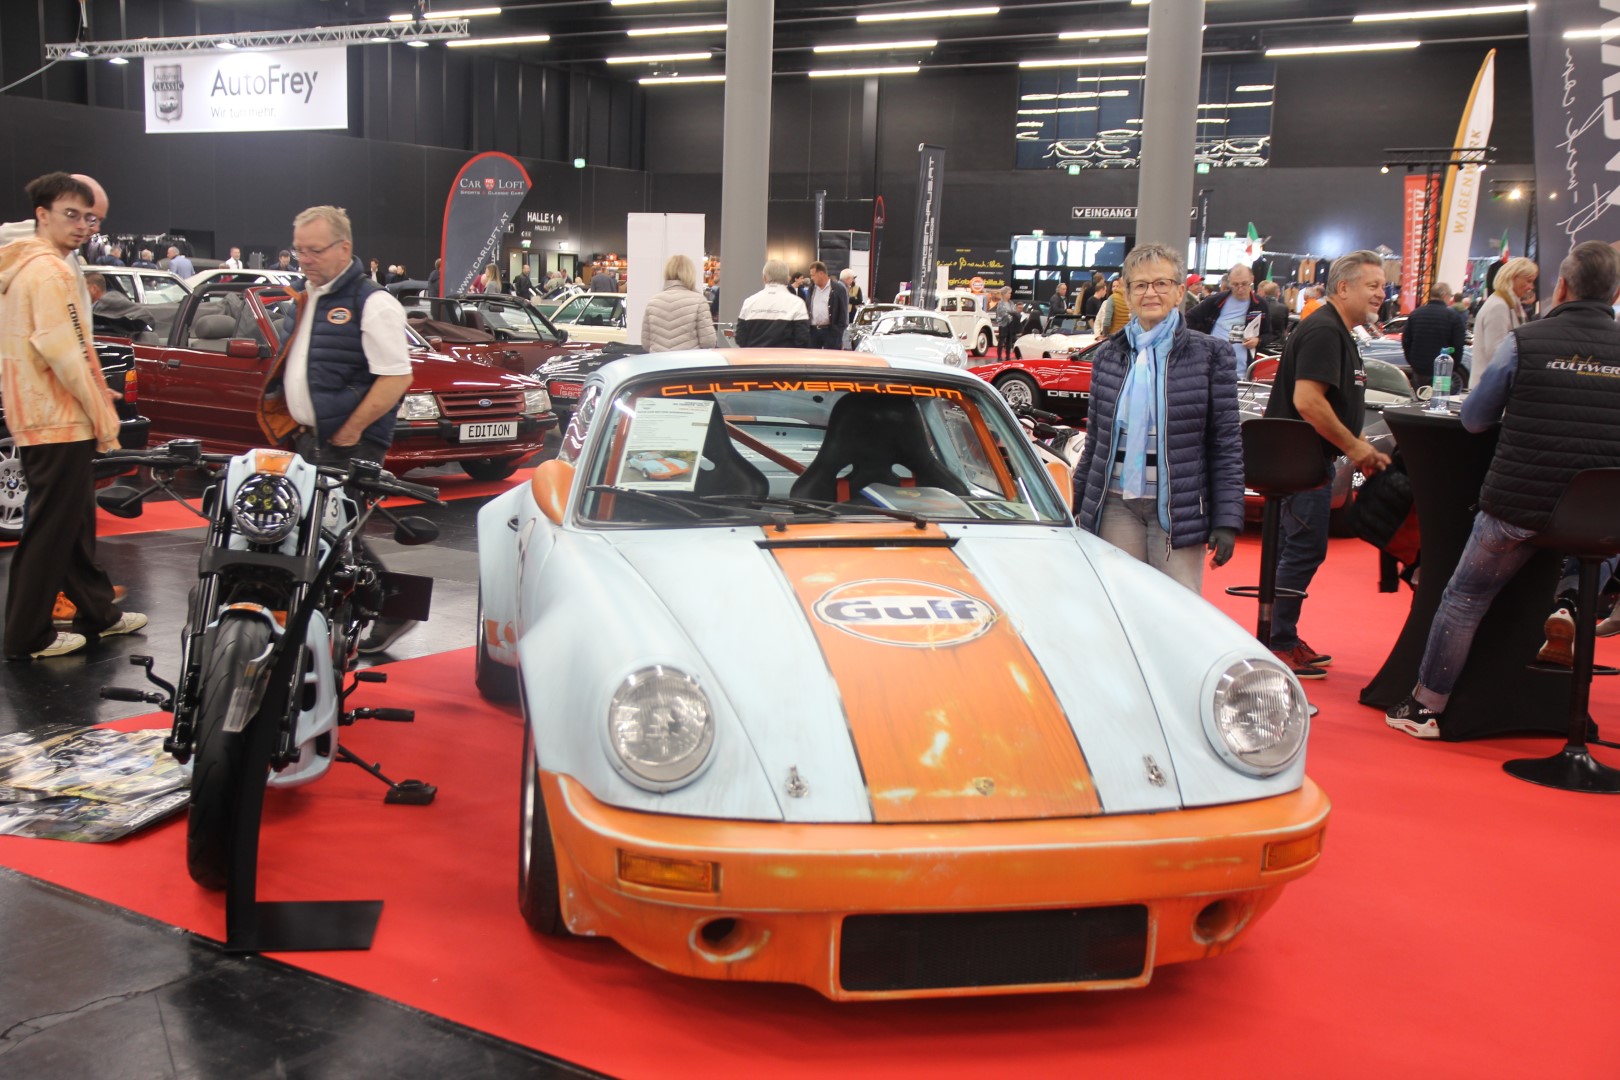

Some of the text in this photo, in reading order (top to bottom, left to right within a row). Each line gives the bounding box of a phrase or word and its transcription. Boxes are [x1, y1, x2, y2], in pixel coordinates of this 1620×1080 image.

[153, 81, 184, 91] CLASSIC
[211, 64, 318, 103] AutoFrey
[210, 106, 226, 117] Wir
[460, 178, 481, 188] CAR
[498, 179, 525, 189] LOFT
[527, 211, 554, 224] HALLE 1
[1084, 208, 1131, 217] EINGANG
[468, 424, 510, 438] EDITION
[824, 599, 979, 620] Gulf
